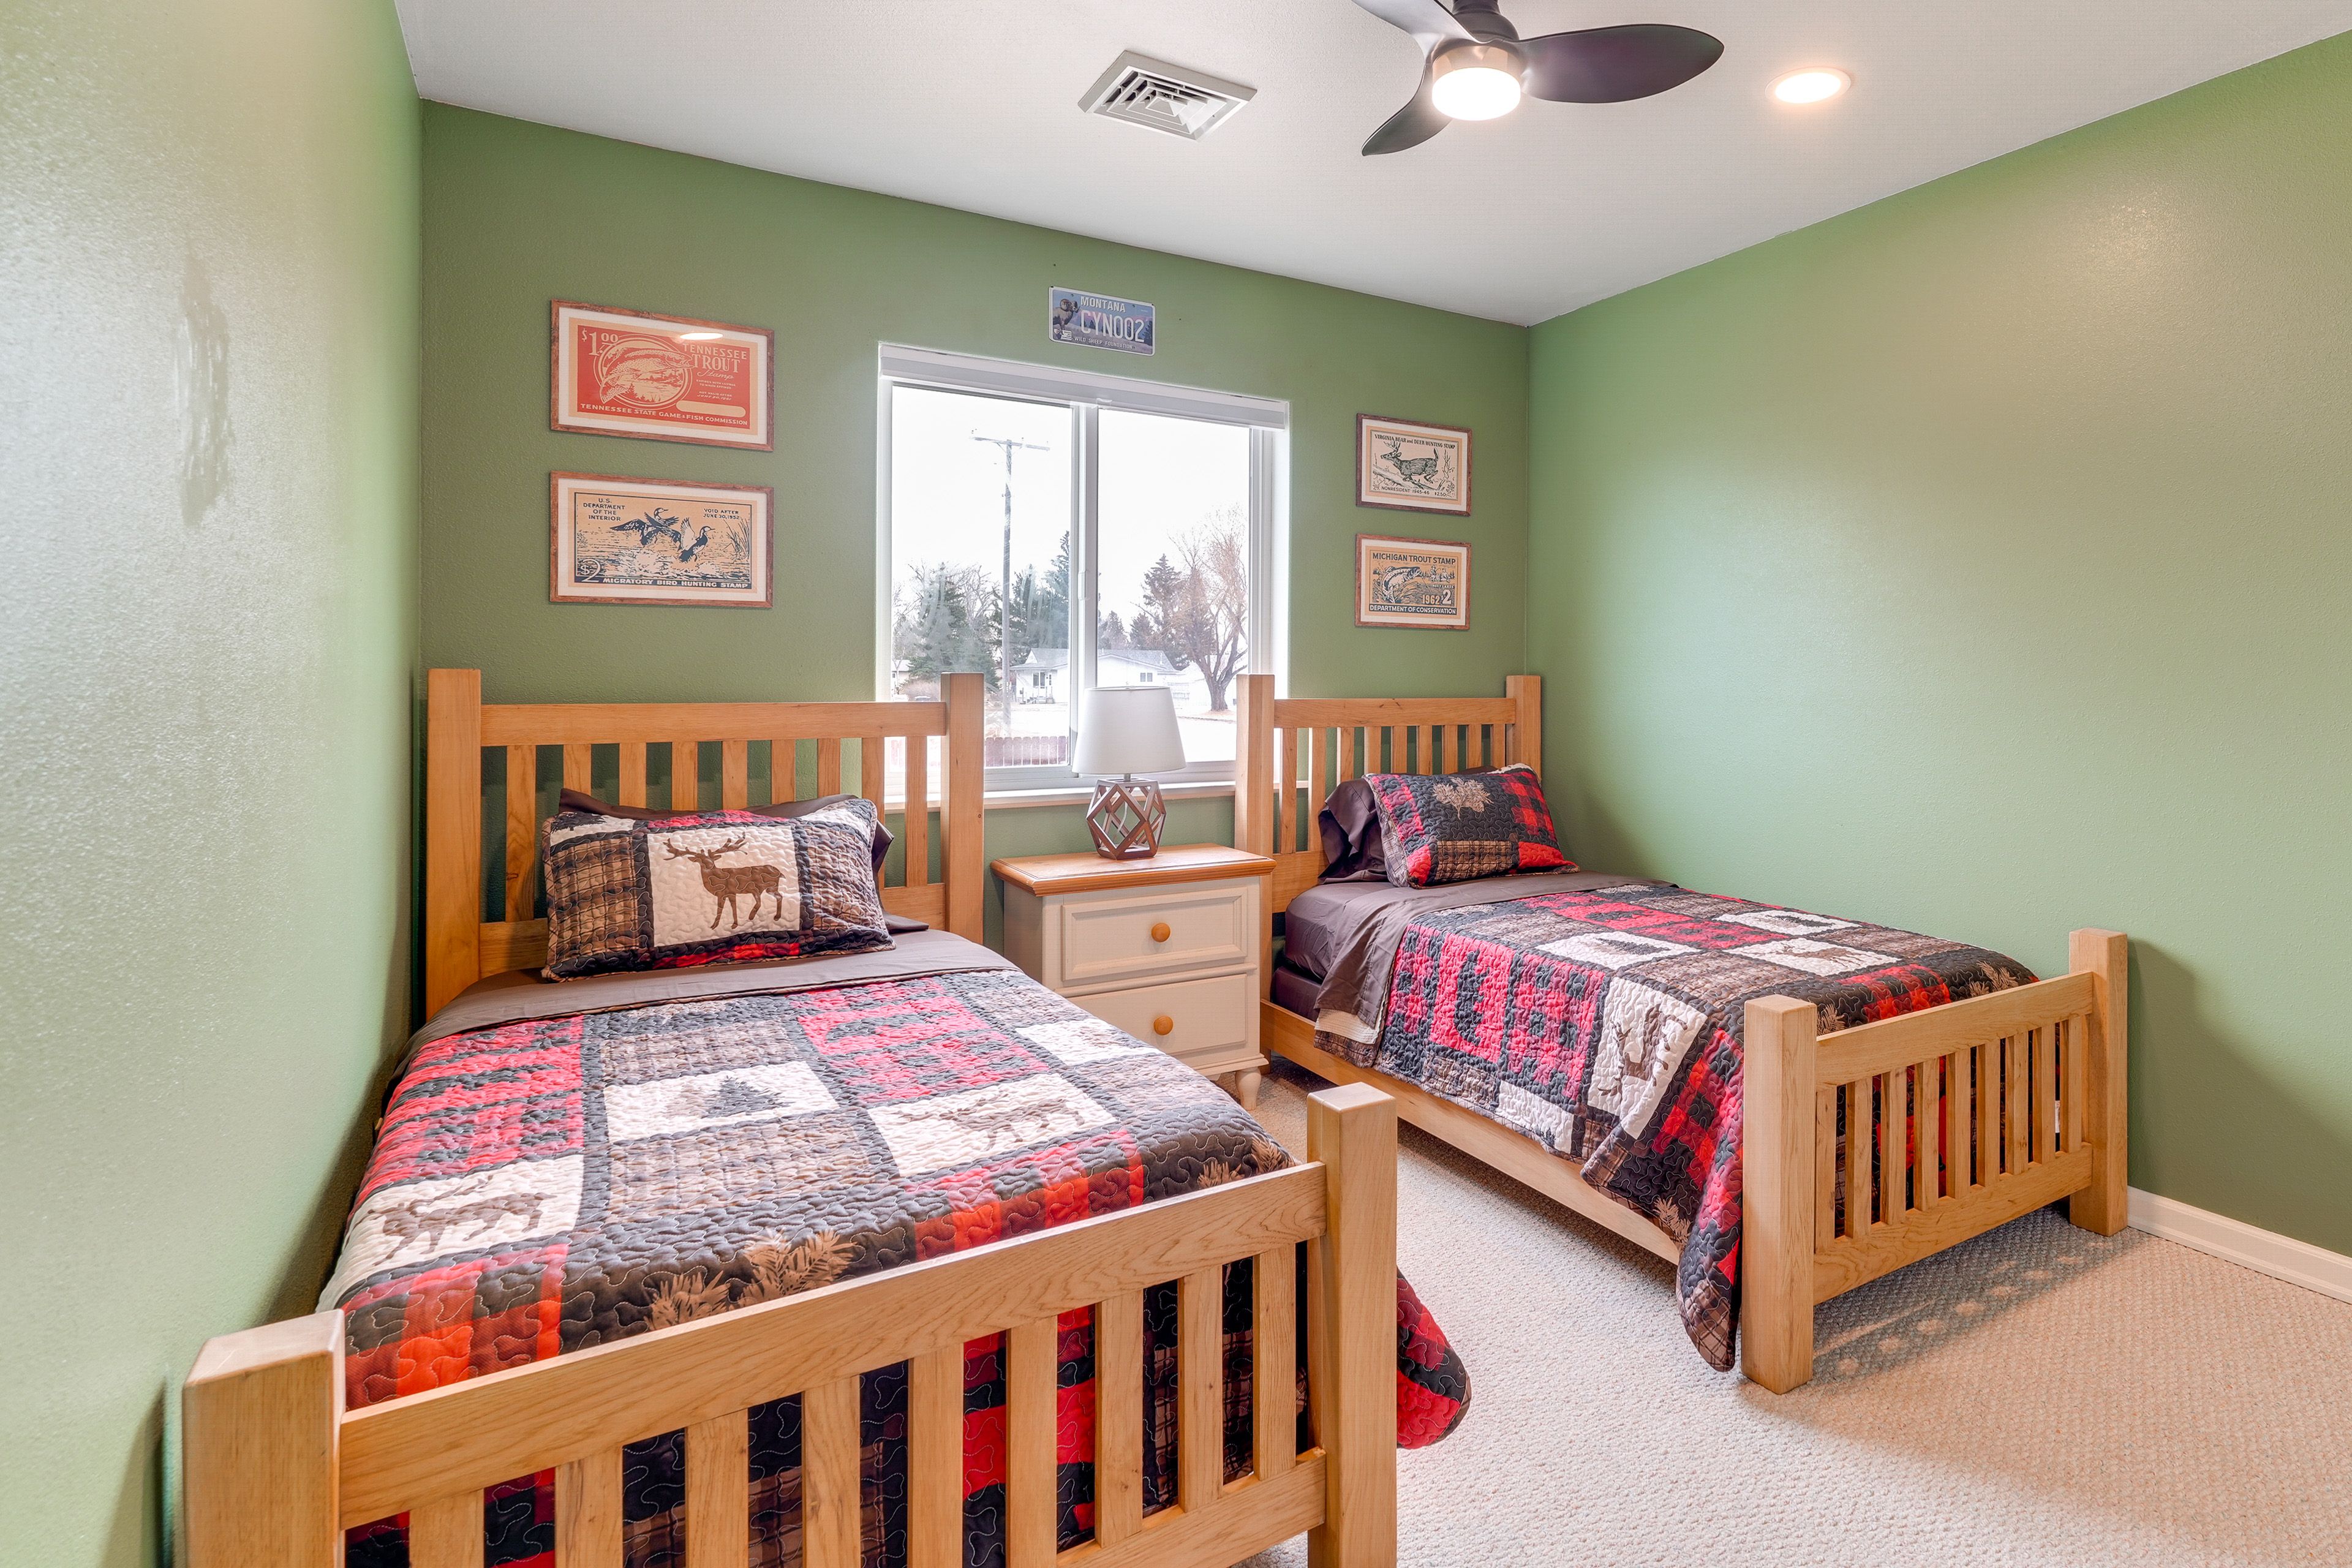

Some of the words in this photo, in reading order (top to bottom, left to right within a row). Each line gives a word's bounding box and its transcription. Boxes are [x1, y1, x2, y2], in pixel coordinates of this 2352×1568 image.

[1080, 296, 1126, 312] MONTANA
[1080, 310, 1145, 342] CYN002
[682, 343, 747, 360] TENNESSEE
[1105, 341, 1133, 349] FOUNDATION
[692, 353, 740, 372] TROUT
[697, 369, 734, 380] Stamp
[581, 403, 631, 413] TENNESSEE
[705, 417, 748, 426] COMMISSION
[1373, 552, 1408, 561] MICHIGAN
[1422, 594, 1440, 605] 1962
